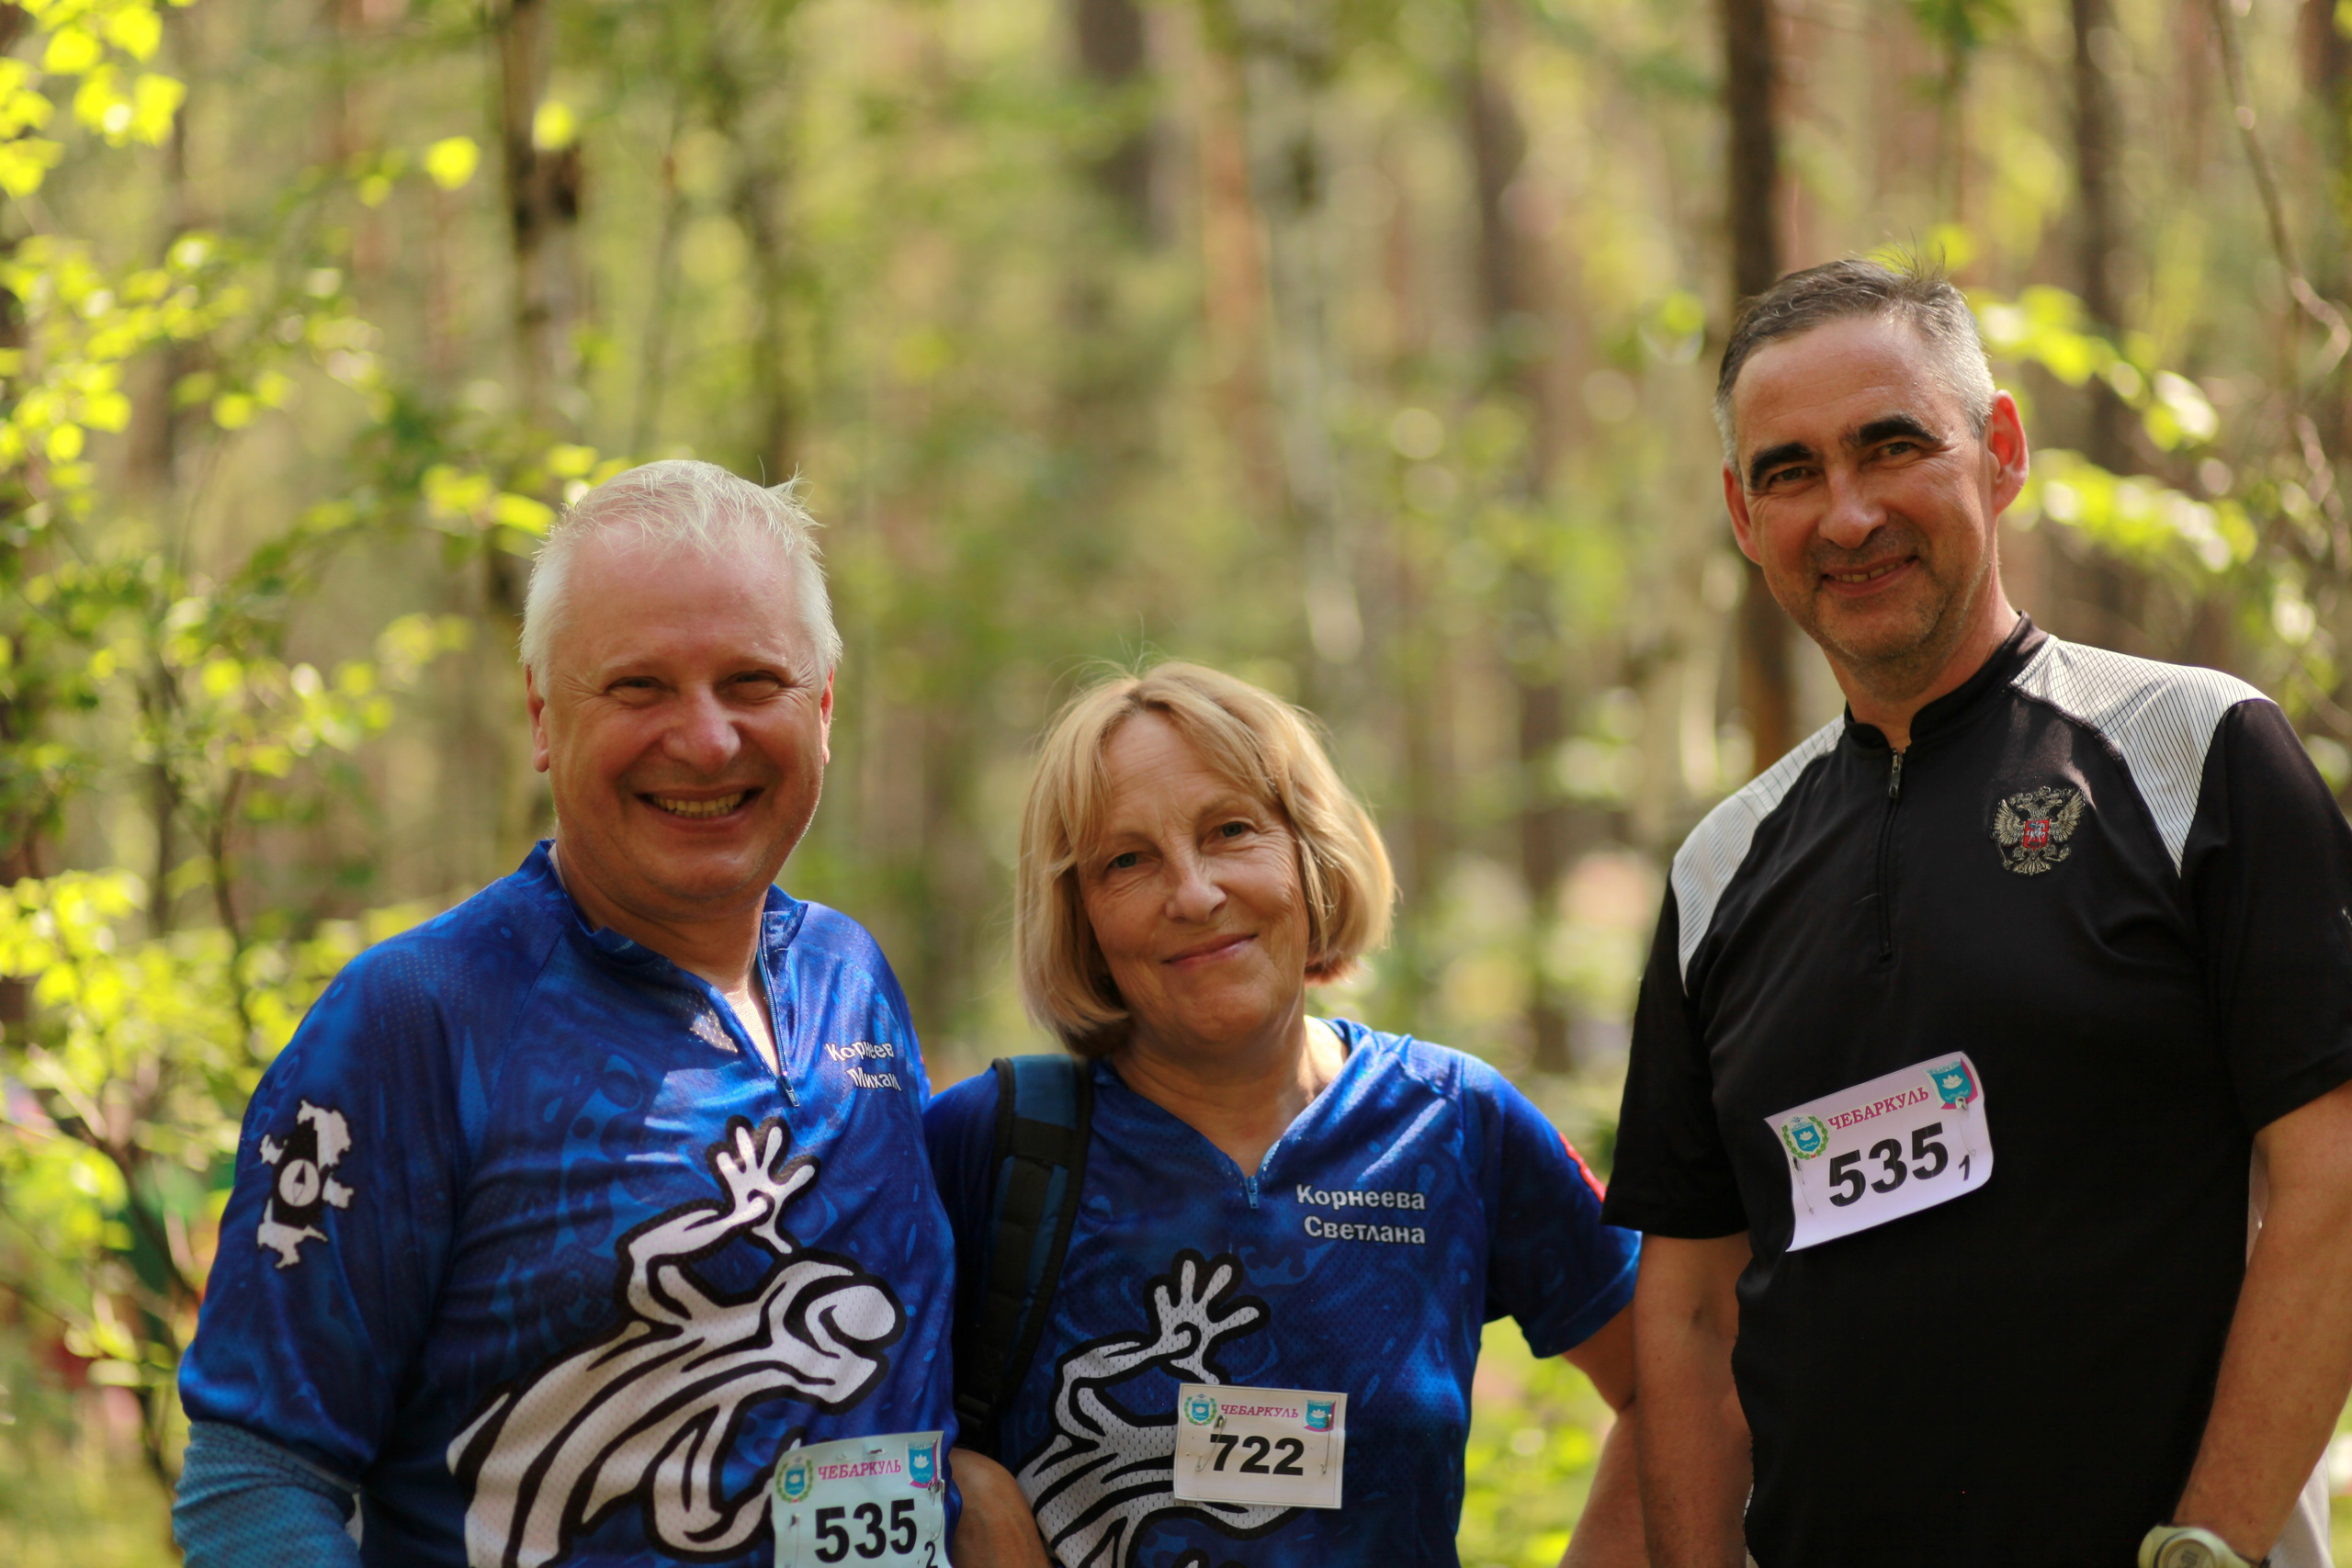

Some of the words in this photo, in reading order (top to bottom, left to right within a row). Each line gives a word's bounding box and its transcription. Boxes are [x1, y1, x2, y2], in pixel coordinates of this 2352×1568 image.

[825, 1041, 894, 1061] Корнеев
[1828, 1087, 1929, 1130] ЧЕБАРКУЛЬ
[1829, 1122, 1949, 1207] 535
[1959, 1155, 1971, 1181] 1
[1296, 1184, 1425, 1210] Корнеева
[1305, 1216, 1425, 1244] Светлана
[1220, 1404, 1299, 1418] ЧЕБАРКУЛЬ
[1210, 1434, 1305, 1475] 722
[818, 1460, 901, 1480] ЧЕБАРКУЛЬ
[815, 1498, 917, 1563] 535
